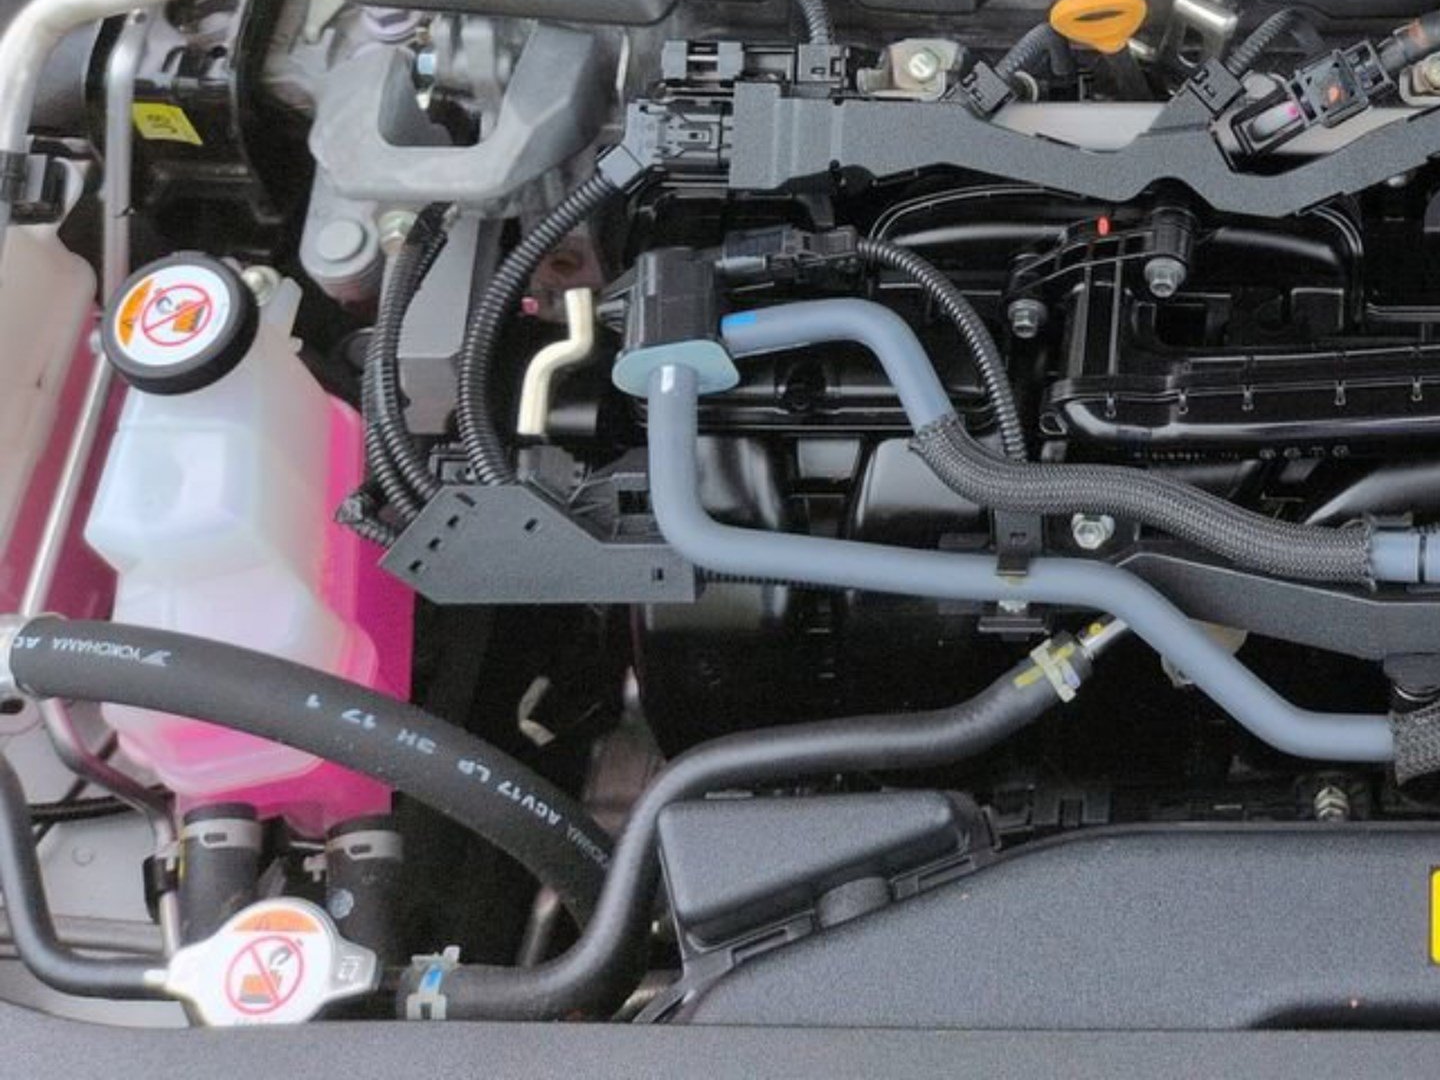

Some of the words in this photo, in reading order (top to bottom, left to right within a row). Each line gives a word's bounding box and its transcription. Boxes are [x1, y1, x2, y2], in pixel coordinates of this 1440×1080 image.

[53, 636, 142, 661] YOKOHAMA
[341, 708, 377, 731] 17
[457, 759, 491, 783] LP
[498, 780, 562, 825] ACV17
